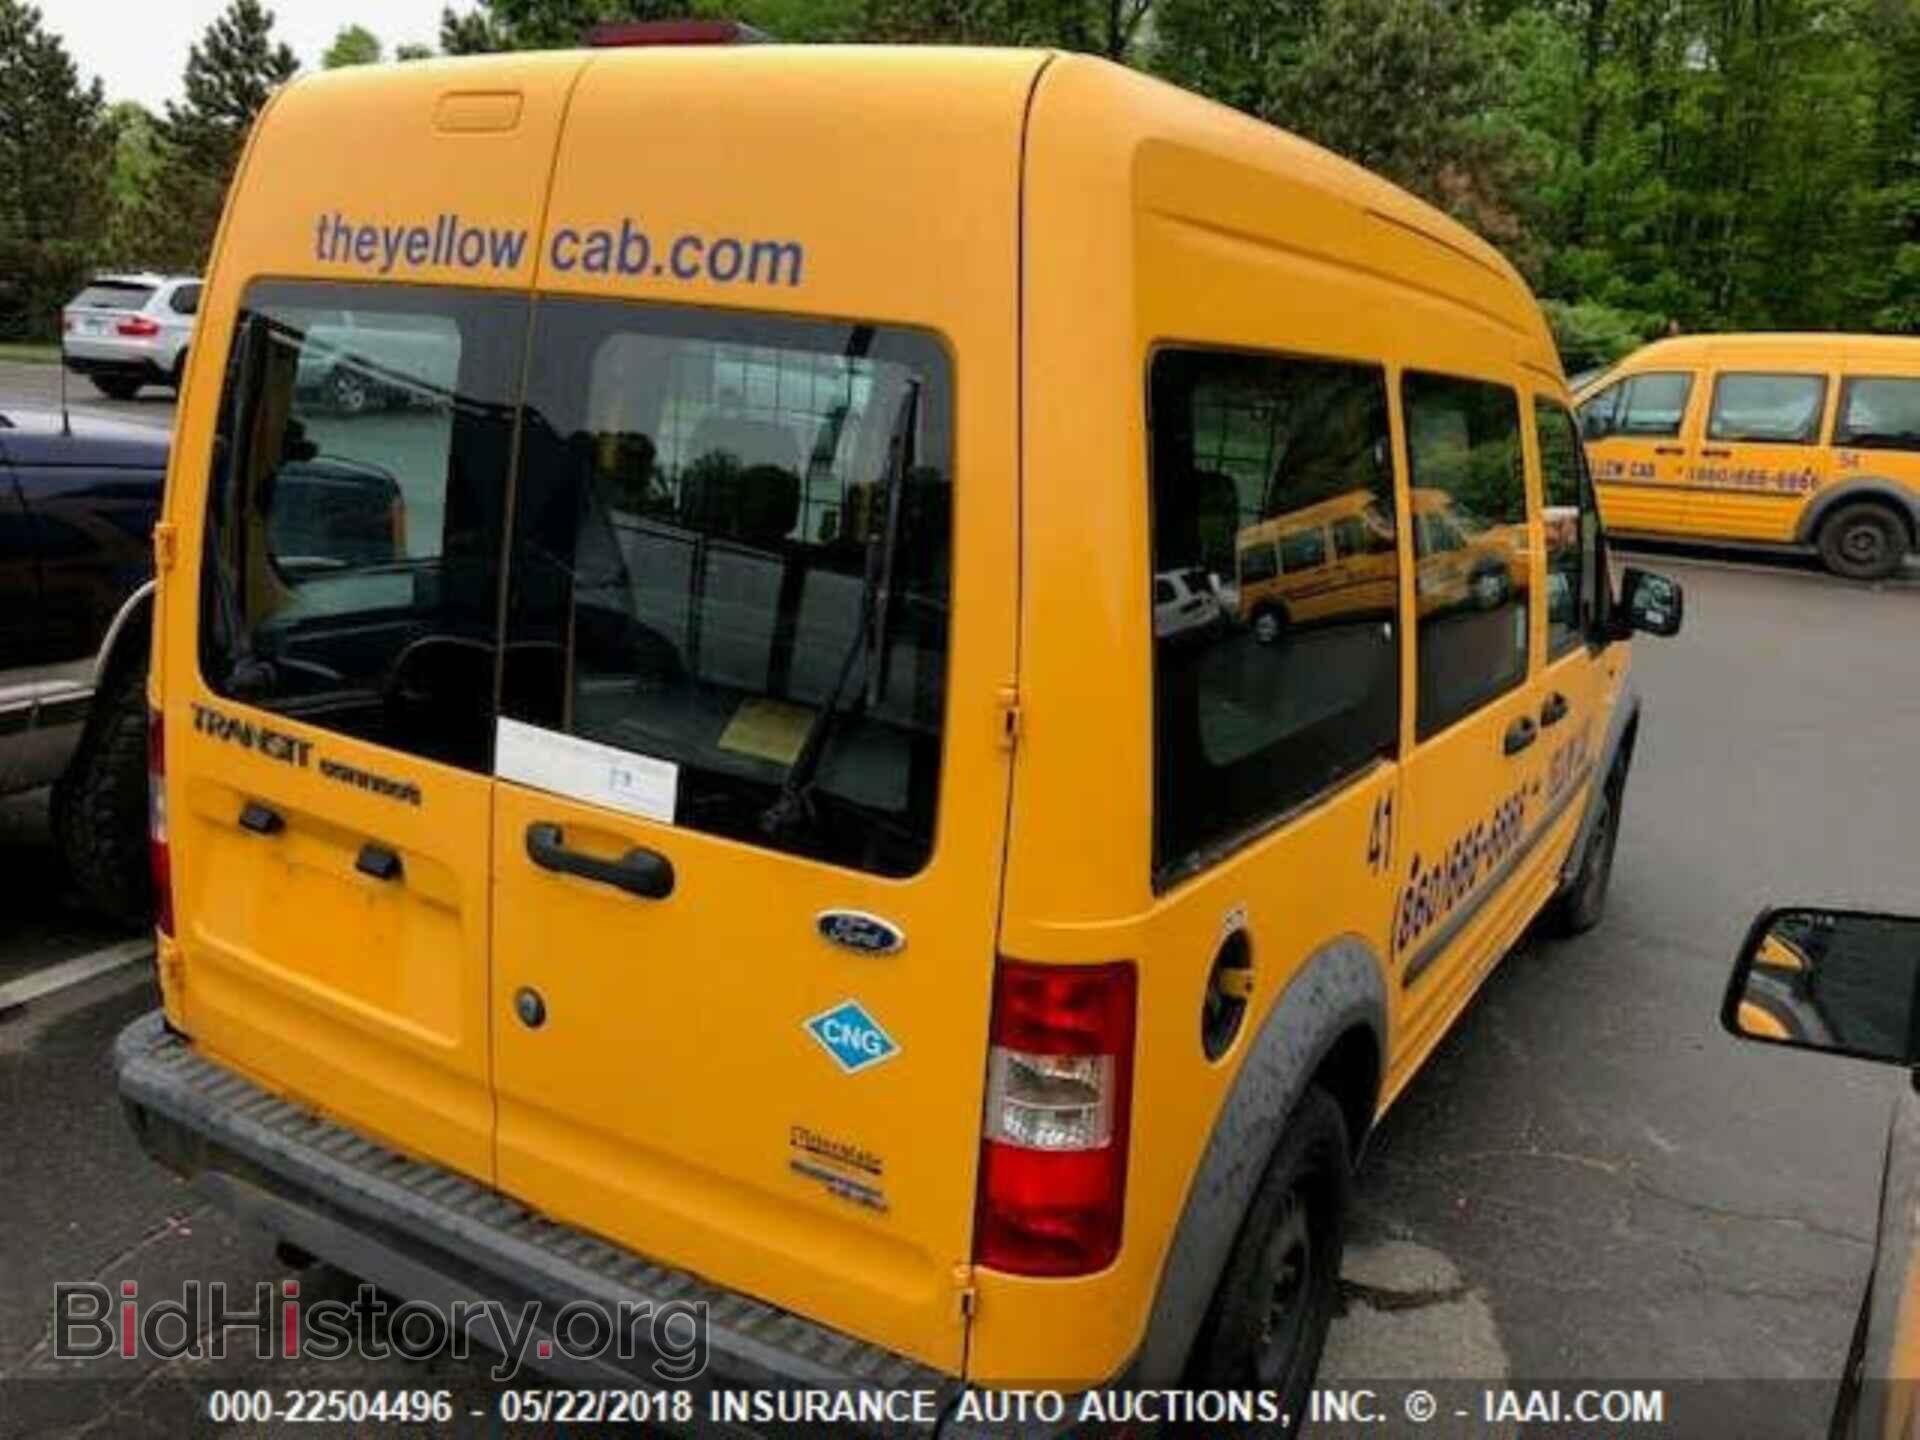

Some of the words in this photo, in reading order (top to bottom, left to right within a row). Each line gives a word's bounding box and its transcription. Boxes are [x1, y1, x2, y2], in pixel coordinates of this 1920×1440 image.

[314, 213, 528, 273] theyellow
[550, 218, 804, 287] cab.com
[190, 702, 315, 768] TRANSIT
[821, 1016, 883, 1055] CNG
